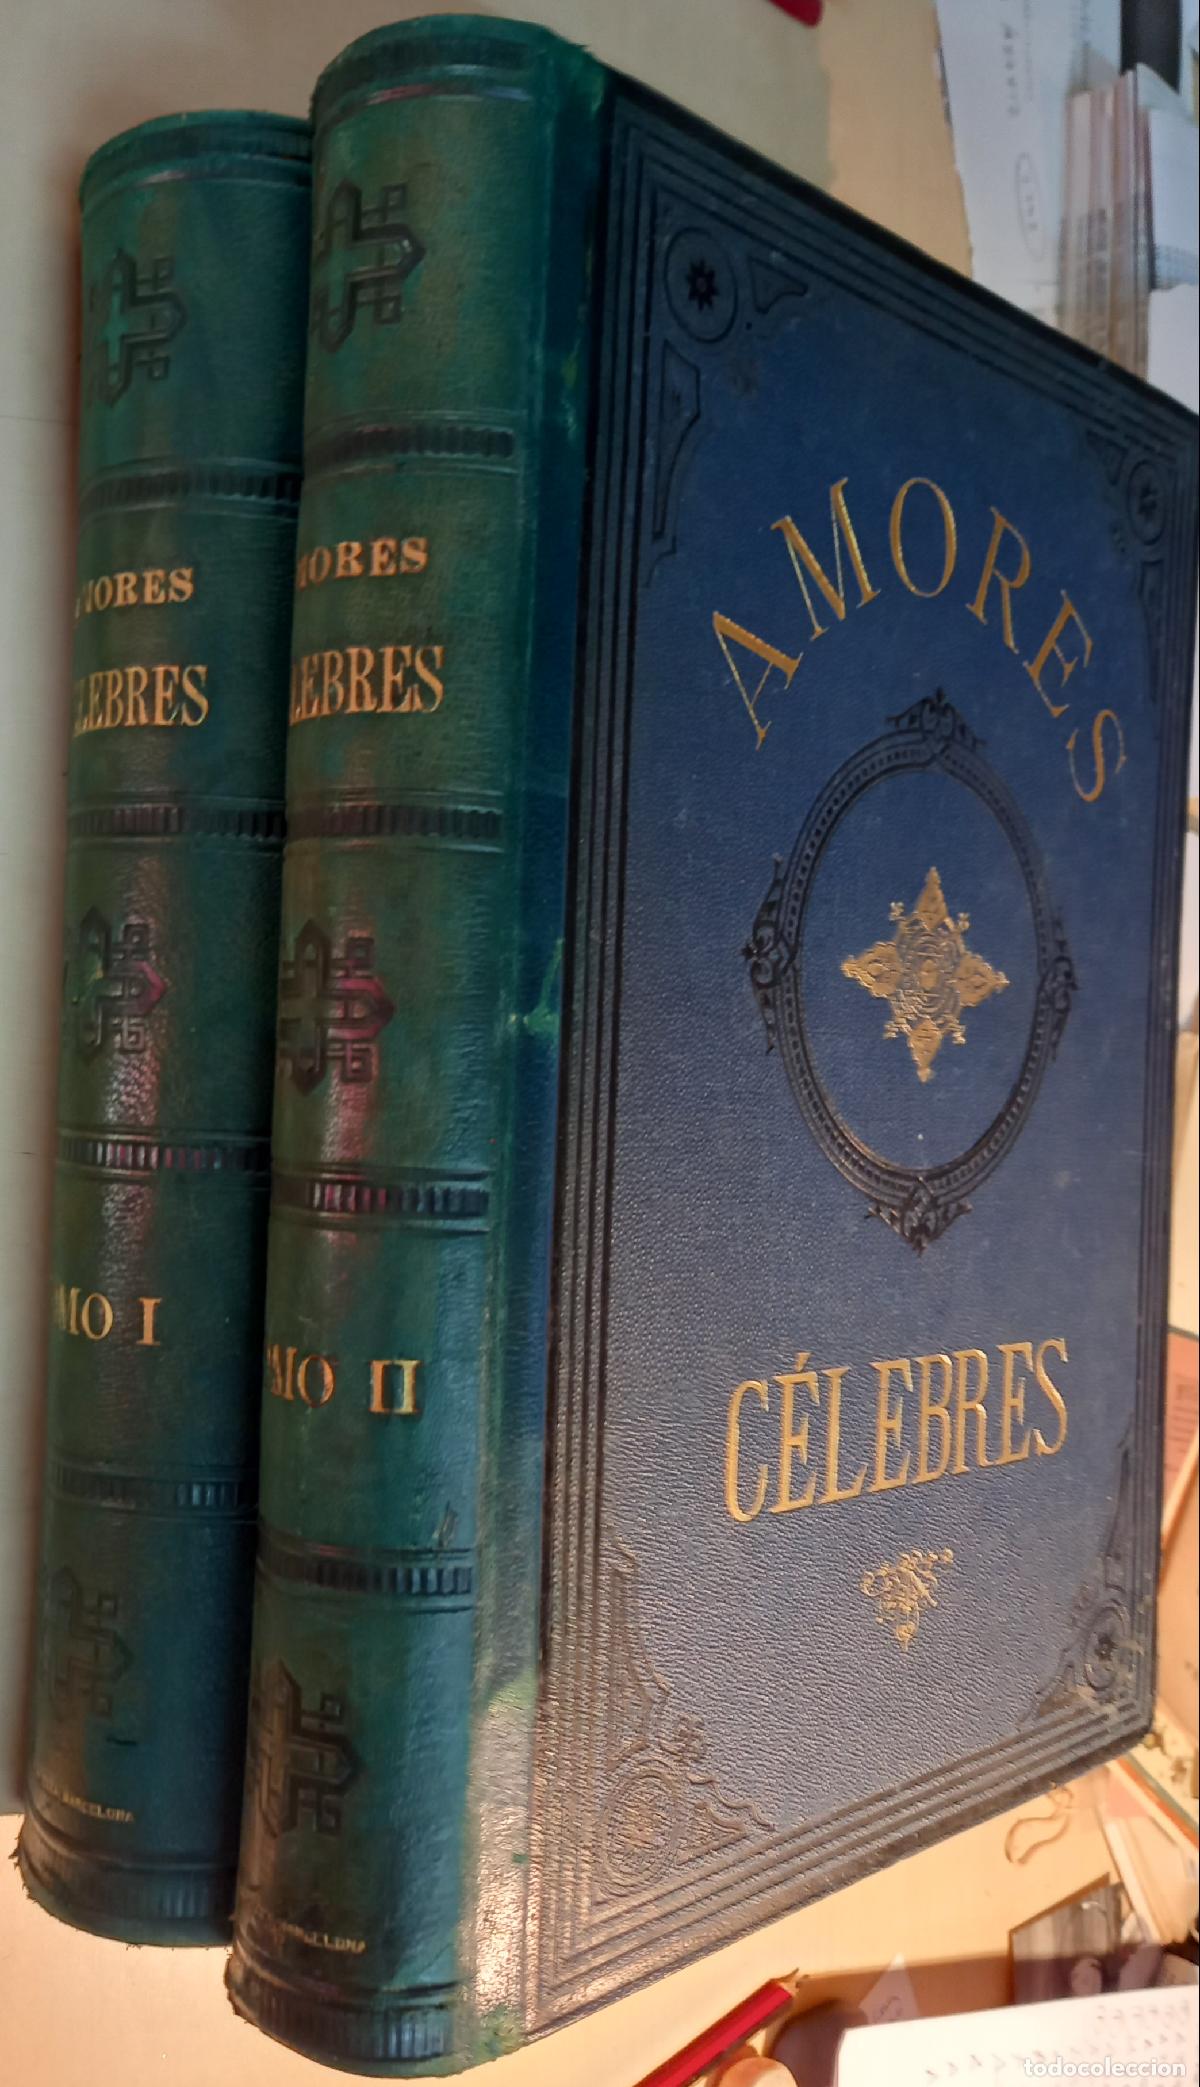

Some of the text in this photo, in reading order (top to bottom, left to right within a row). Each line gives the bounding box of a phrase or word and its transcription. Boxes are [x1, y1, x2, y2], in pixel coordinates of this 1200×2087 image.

[712, 476, 1127, 803] AMORES
[136, 1296, 162, 1346] I
[369, 1359, 422, 1414] II
[724, 1337, 1069, 1522] CÉLEBRES
